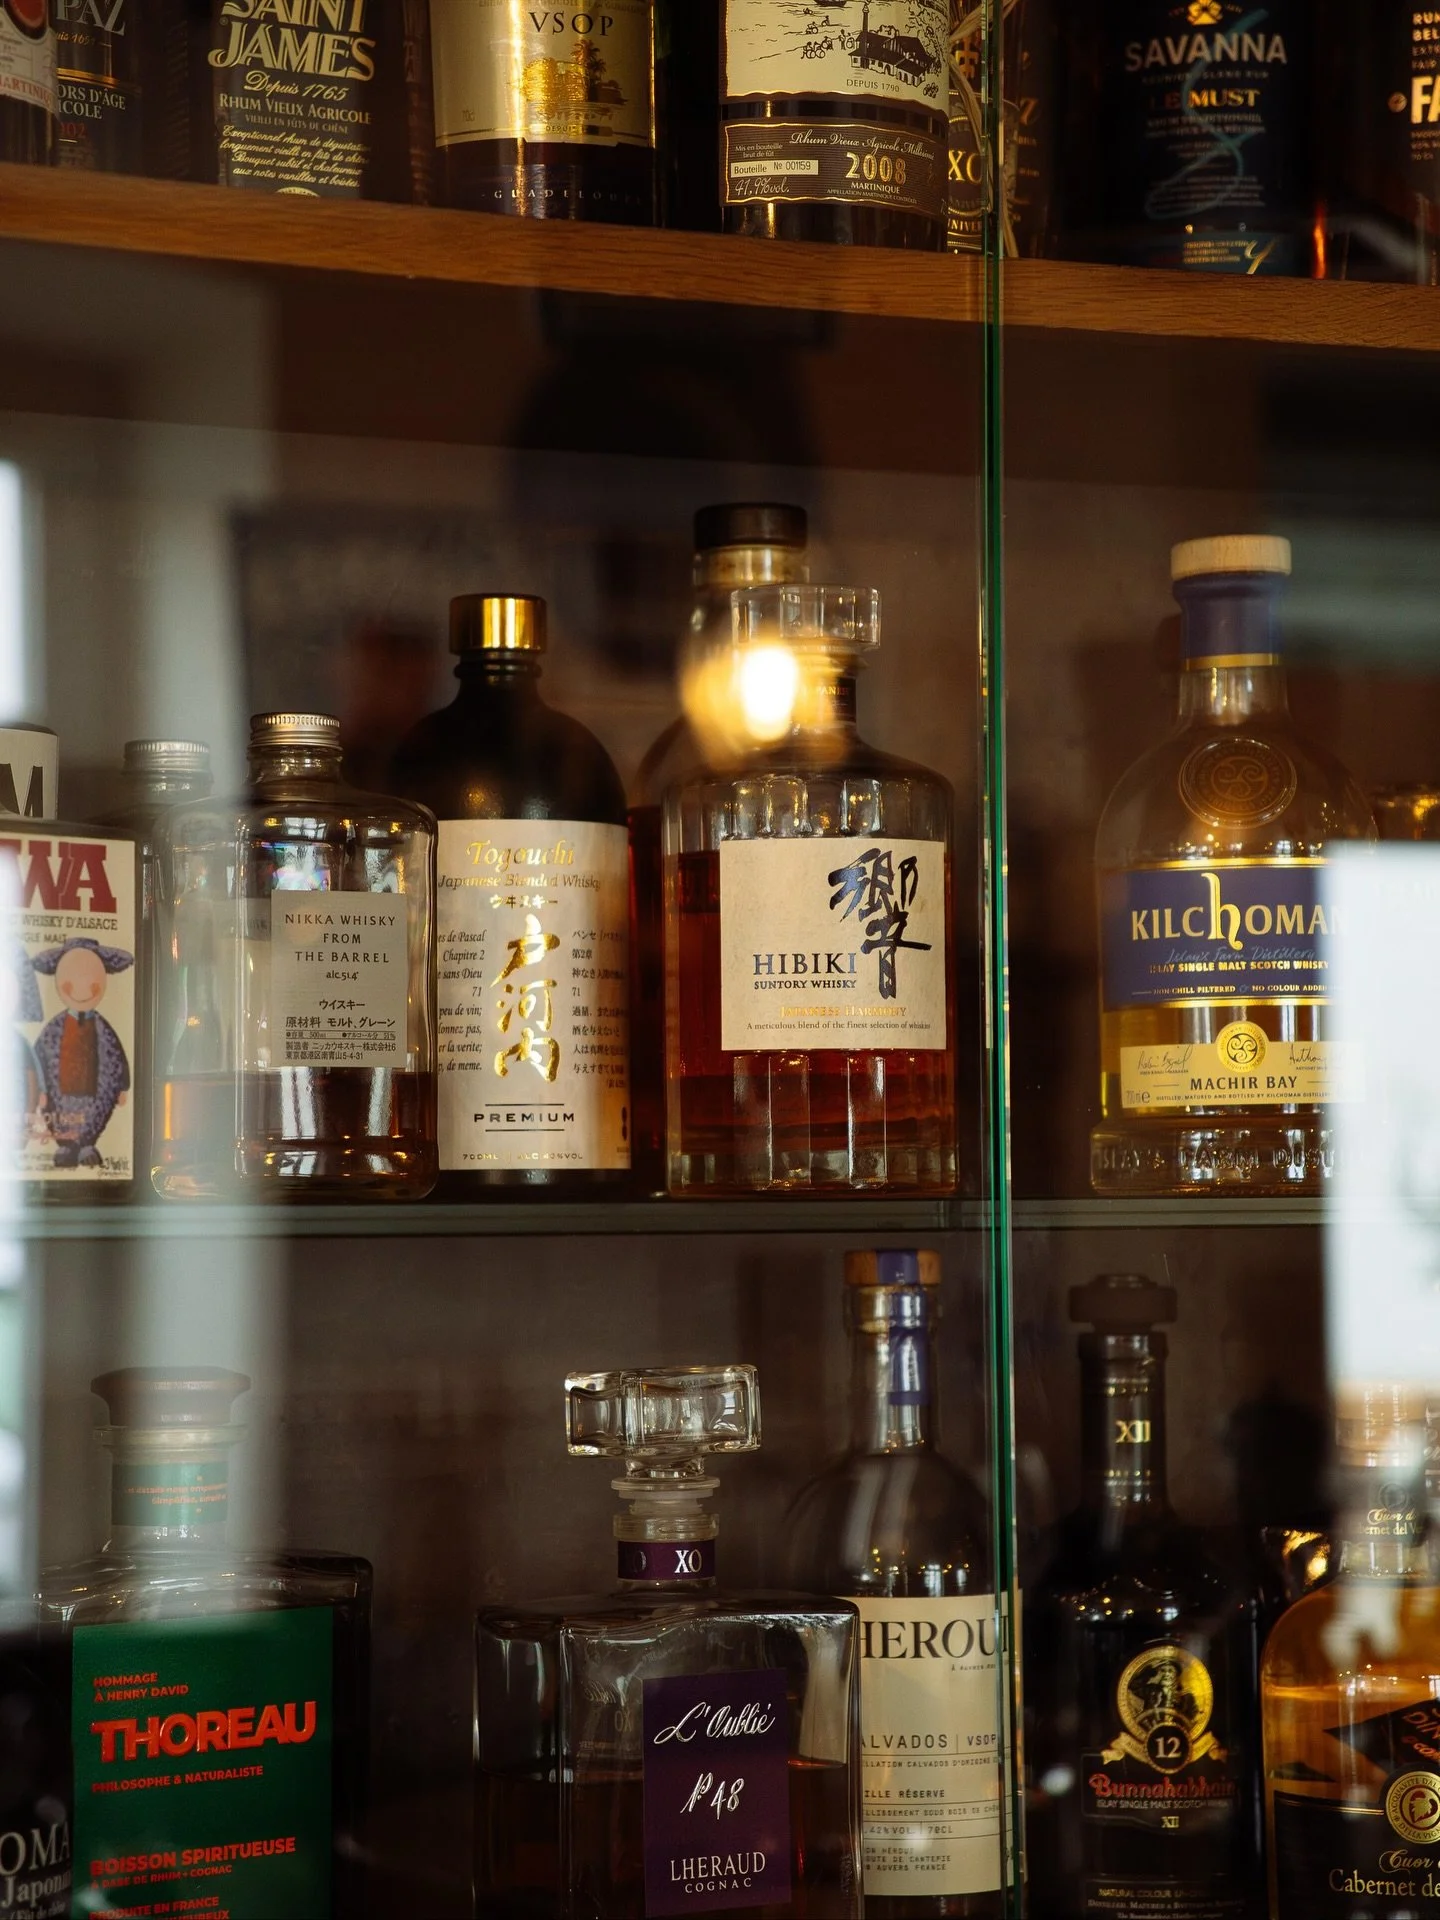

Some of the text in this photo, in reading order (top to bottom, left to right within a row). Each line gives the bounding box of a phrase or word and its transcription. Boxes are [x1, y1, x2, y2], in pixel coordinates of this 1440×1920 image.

[529, 11, 614, 36] VSOP
[207, 21, 377, 82] JAMES
[1124, 32, 1287, 72] SAVANNA
[57, 84, 86, 101] ORS
[242, 71, 350, 101] Depuis 1765
[846, 78, 878, 90] DEPUIS
[1189, 88, 1262, 109] MUST
[58, 100, 102, 119] ICOLE
[219, 93, 373, 126] RHUM VIEUX AGRICOLE
[789, 129, 900, 157] Rhum Vieux Agricole
[734, 164, 767, 174] Bouteille
[845, 151, 907, 186] 2008
[851, 183, 901, 194] MARTINIQUE
[466, 839, 574, 873] Togouchi
[438, 874, 499, 891] Japanese
[66, 914, 118, 931] D'ALSACE
[285, 914, 395, 926] NIKKA WHISKY
[323, 933, 361, 944] FROM
[458, 930, 487, 942] Pascal
[295, 951, 389, 963] THE BARREL
[443, 949, 485, 965] Chapitre 2
[752, 953, 857, 975] HIBIKI
[443, 967, 483, 980] sans Dieu
[1178, 960, 1330, 974] SINGLE MALT SCOTCH WHISKY
[472, 986, 482, 997] 71
[754, 980, 857, 991] SUNTORY WHISKY
[1198, 985, 1236, 994] FILTERED
[1252, 985, 1265, 993] NO
[1267, 984, 1300, 993] COLOUR
[319, 999, 366, 1010] ウイスキー
[440, 1007, 453, 1019] peu
[454, 1004, 464, 1015] de
[780, 1005, 909, 1018] JAPANESE HARMONY
[746, 1022, 754, 1031] A
[755, 1021, 797, 1030] meticulous
[798, 1019, 820, 1030] blend
[821, 1020, 831, 1030] of
[832, 1020, 845, 1030] the
[846, 1020, 868, 1030] finest
[869, 1020, 900, 1030] selection
[1190, 1075, 1298, 1091] MACHIR BAY
[473, 1112, 575, 1124] PREMIUM
[1115, 1419, 1152, 1444] XII
[674, 1549, 702, 1573] XO
[93, 1672, 158, 1689] HOMMAGE
[107, 1687, 149, 1702] HENRY
[151, 1684, 190, 1698] DAVID
[91, 1701, 317, 1763] THOREAU
[1154, 1736, 1182, 1759] 12
[92, 1765, 264, 1794] PHILOSOPHE & NATURALISTE
[899, 1786, 945, 1798] RÉSERVE
[1160, 1816, 1180, 1829] XII
[90, 1836, 297, 1878] BOISSON SPIRITUEUSE
[151, 1870, 181, 1884] RHUM
[189, 1865, 234, 1879] COGNAC
[670, 1851, 767, 1882] LHERAUD
[685, 1876, 753, 1894] COGNAC
[1329, 1869, 1416, 1894] Cabernet
[154, 1902, 169, 1914] EN
[172, 1896, 220, 1912] FRANCE
